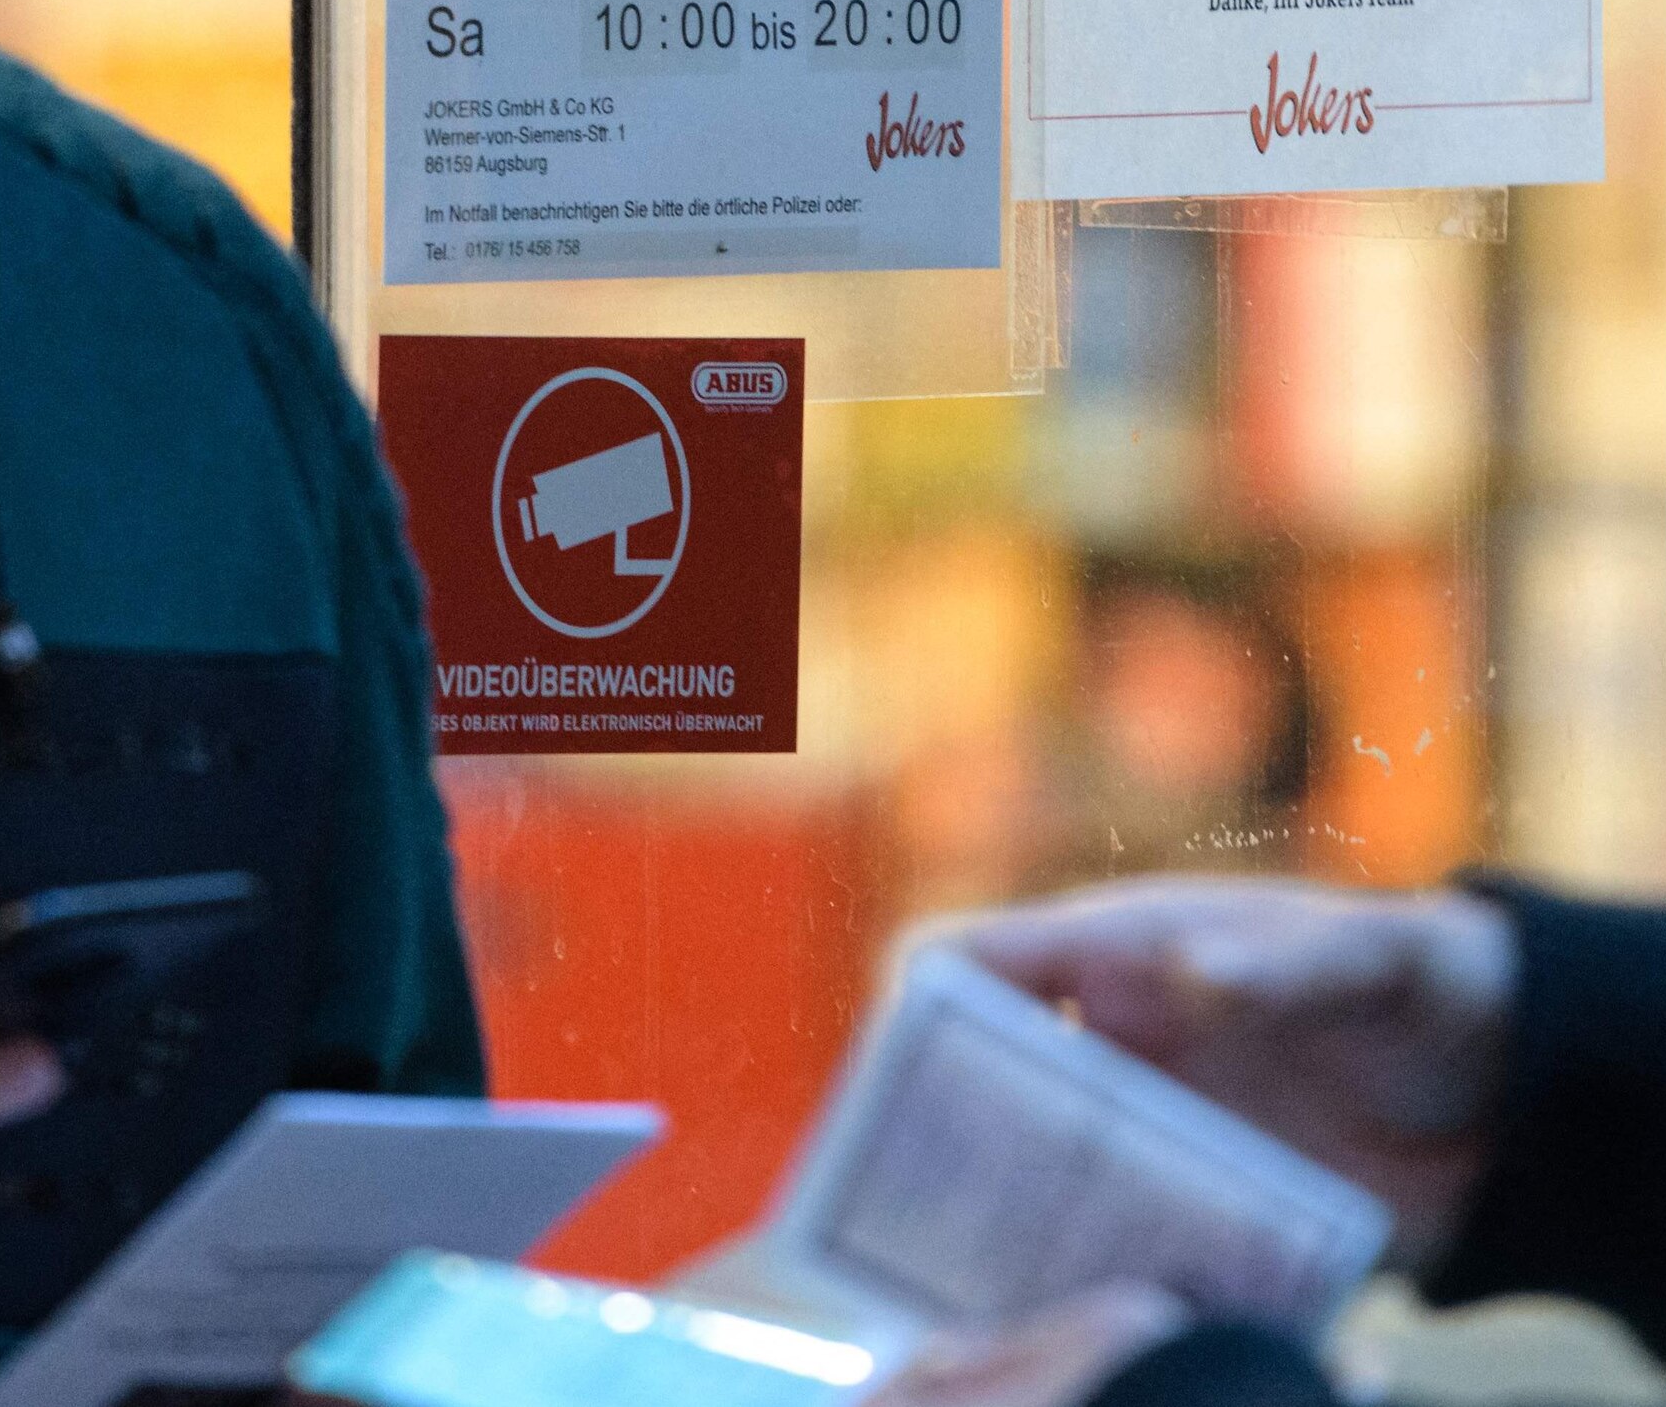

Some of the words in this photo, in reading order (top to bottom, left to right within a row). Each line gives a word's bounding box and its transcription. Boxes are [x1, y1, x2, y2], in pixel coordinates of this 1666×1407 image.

[426, 6, 484, 58] Sa
[752, 13, 796, 51] bis
[425, 100, 492, 119] JOKERS
[497, 99, 543, 117] GmbH
[550, 98, 560, 115] &
[564, 98, 585, 115] Co
[591, 97, 614, 115] KG
[1250, 51, 1374, 154] Jokers
[425, 124, 611, 145] Werner-von-Siemens-Str.
[618, 124, 624, 141] 1
[866, 92, 966, 172] Jokers
[425, 156, 473, 173] 86159
[476, 155, 547, 176] Augsburg
[426, 206, 444, 223] Im
[450, 204, 497, 222] Notfall
[502, 201, 618, 223] benachrichtigen
[624, 200, 648, 218] Sie
[653, 200, 683, 217] bitte
[689, 198, 710, 216] die
[715, 198, 767, 215] örtliche
[773, 197, 820, 214] Polizei
[825, 197, 861, 213] oder:
[509, 240, 523, 257] 15
[705, 373, 773, 392] ABUS
[437, 657, 735, 699] VIDEOÜBERWACHUNG
[463, 715, 519, 732] OBJEKT
[522, 715, 559, 732] WIRD
[564, 715, 671, 732] ELEKTRONISCH
[675, 710, 764, 732] ÜBERWACHT
